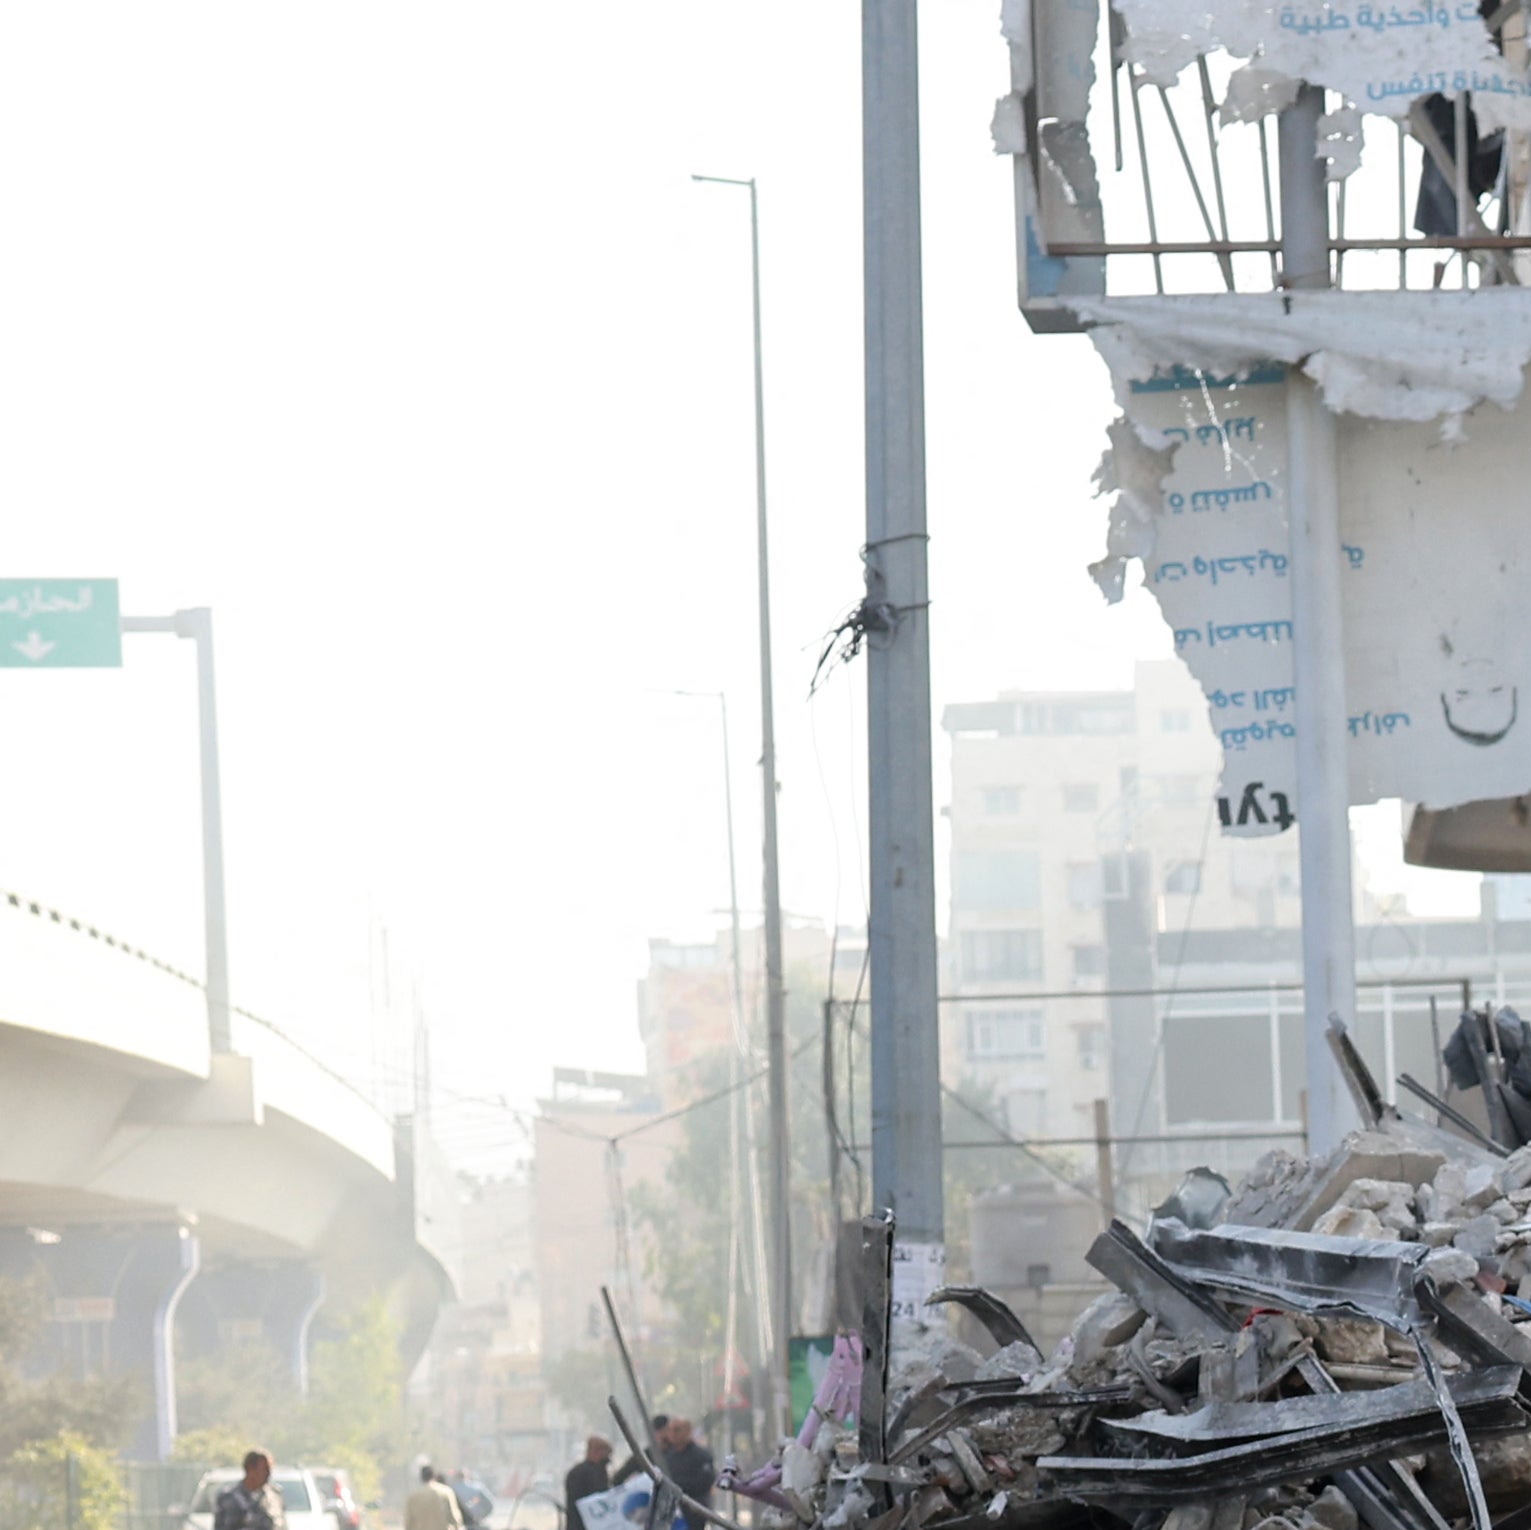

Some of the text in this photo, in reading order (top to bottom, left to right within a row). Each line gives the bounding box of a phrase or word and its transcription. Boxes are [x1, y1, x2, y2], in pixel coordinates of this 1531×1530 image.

[1280, 7, 1350, 35] طبية
[1366, 71, 1448, 101] تنفس
[1191, 482, 1272, 513] تنفس
[1192, 551, 1288, 586] وأحذية
[1206, 620, 1294, 649] إصطنا
